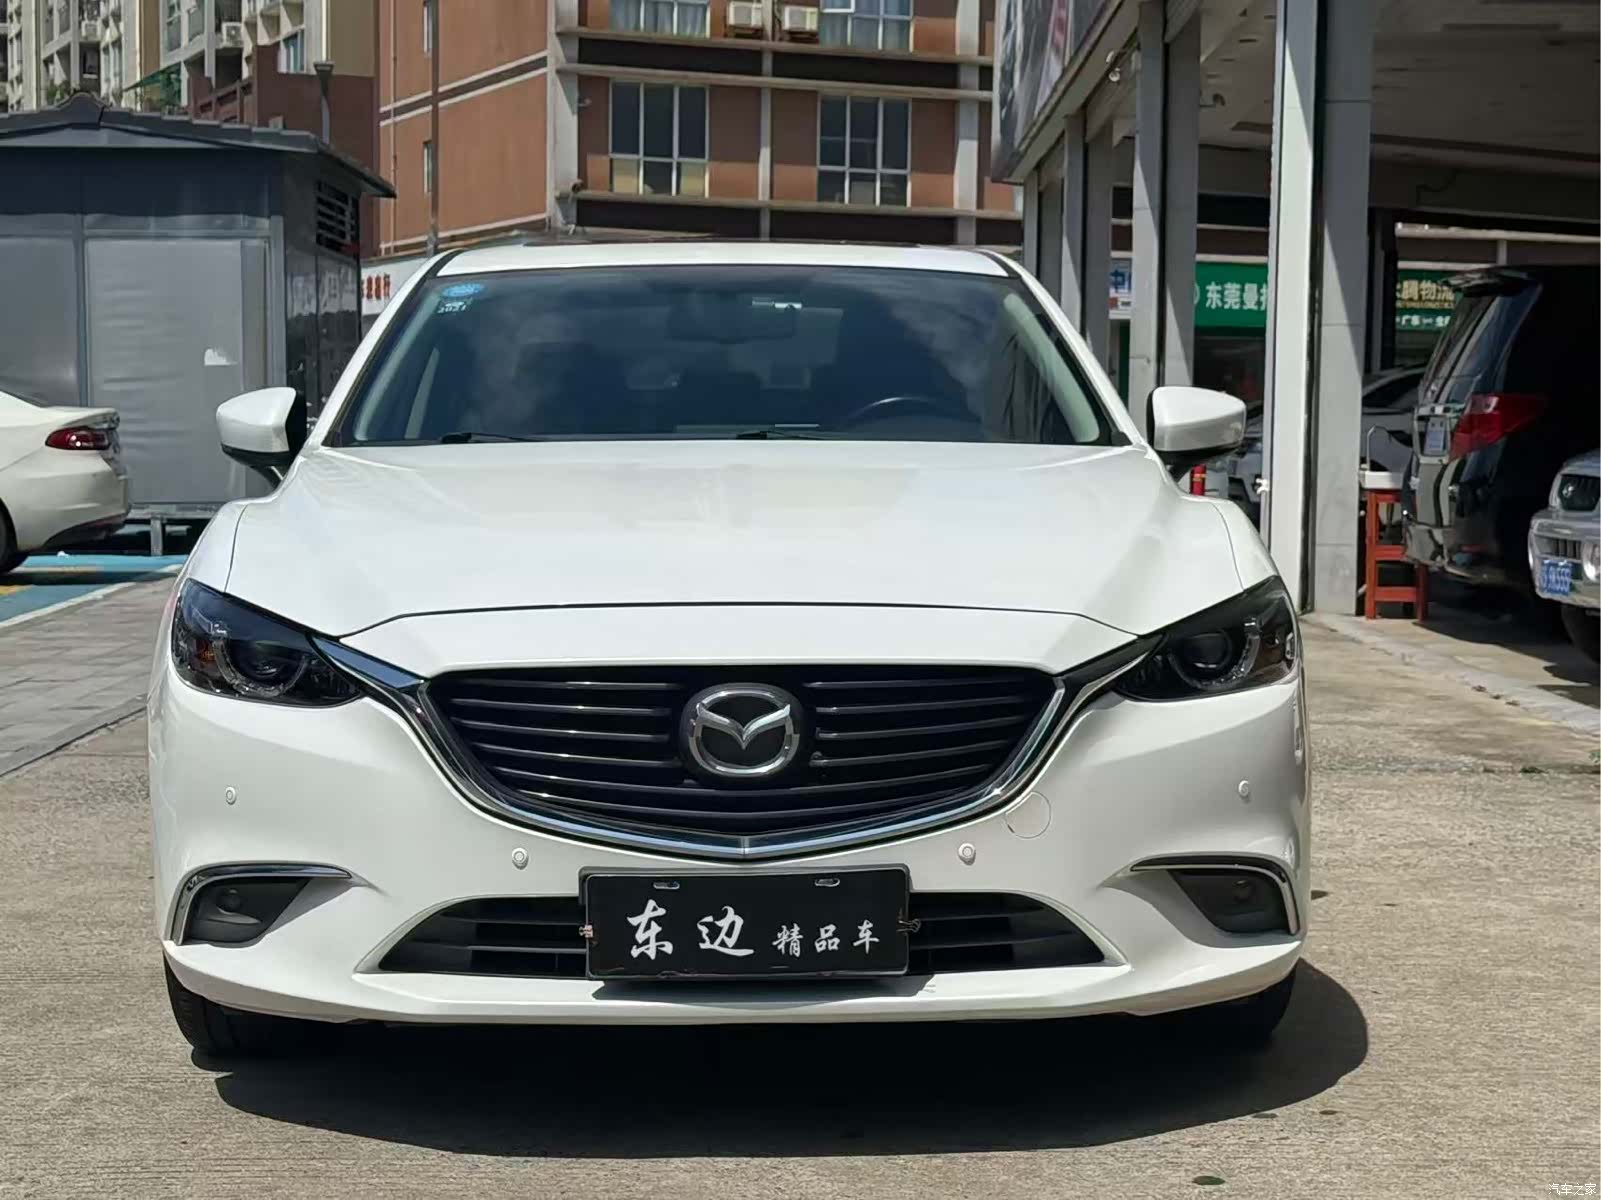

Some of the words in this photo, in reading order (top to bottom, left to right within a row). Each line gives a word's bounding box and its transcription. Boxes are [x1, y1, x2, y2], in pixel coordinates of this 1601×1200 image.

[626, 898, 755, 961] 东边
[771, 919, 880, 958] 精品车
